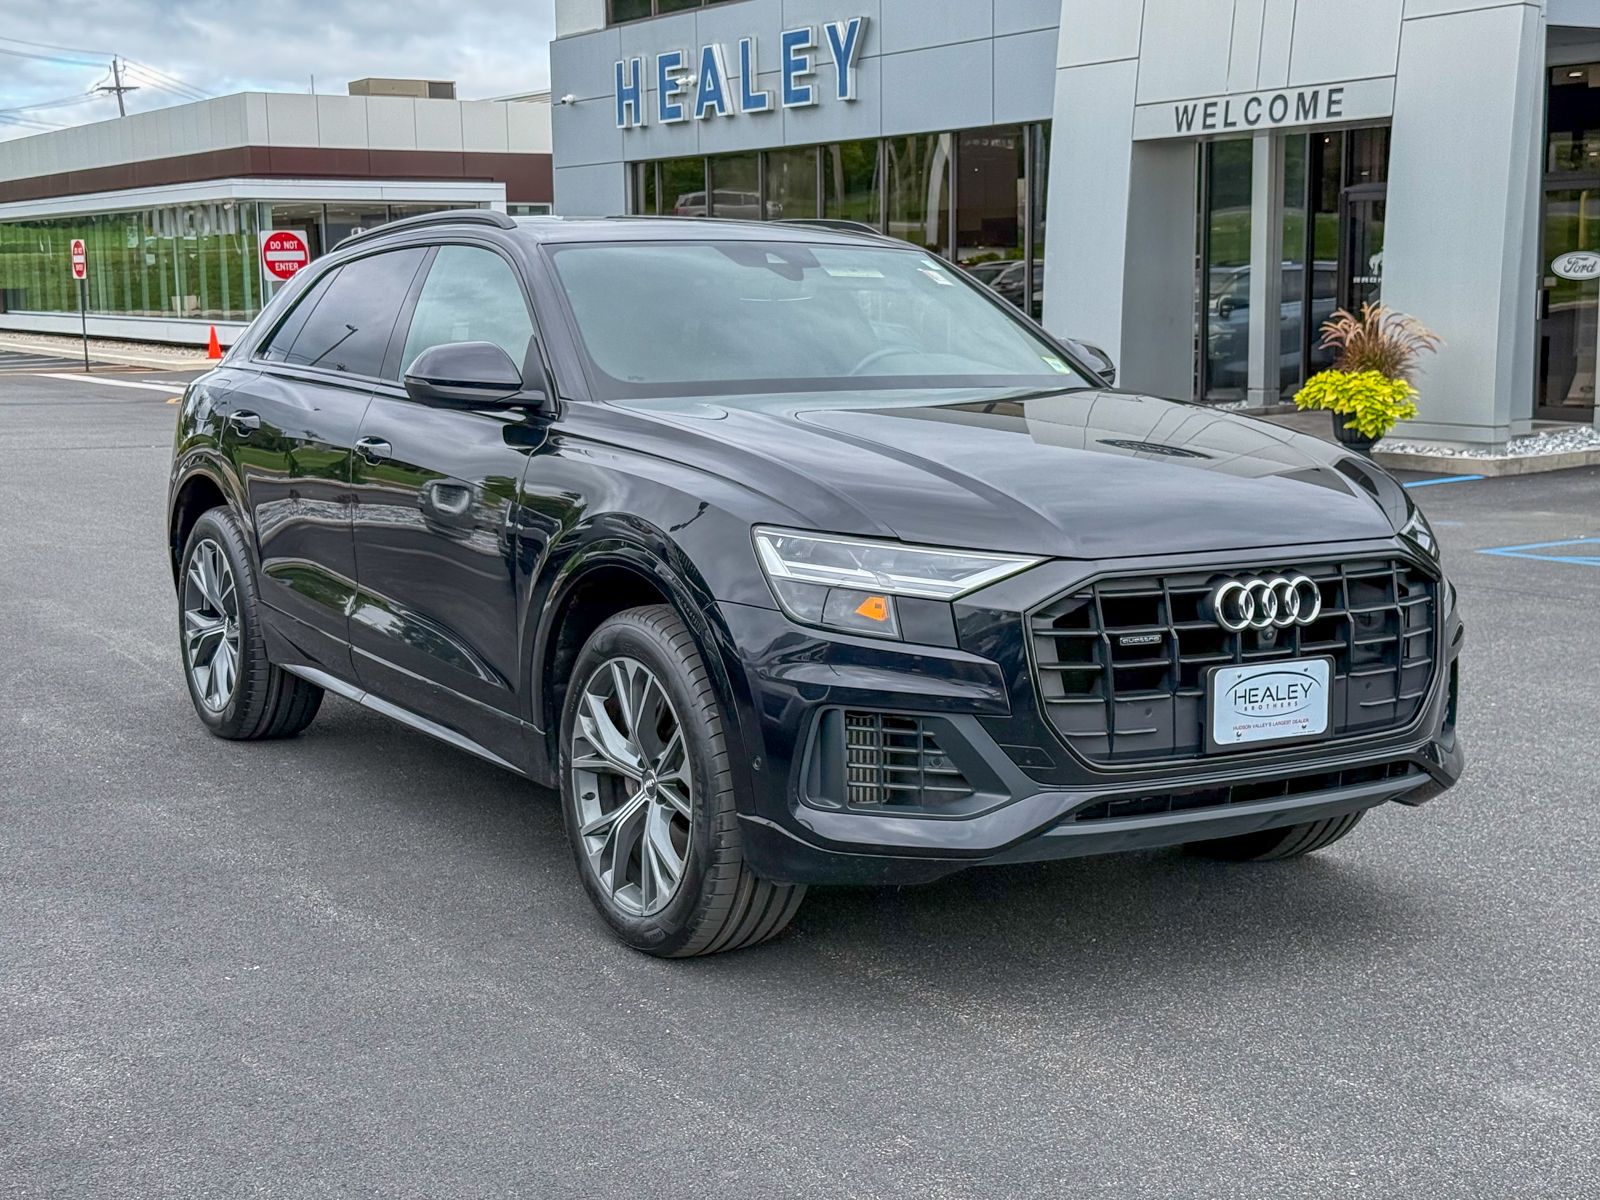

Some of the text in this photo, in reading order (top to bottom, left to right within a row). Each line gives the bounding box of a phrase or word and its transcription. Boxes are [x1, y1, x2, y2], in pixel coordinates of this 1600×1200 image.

[614, 16, 869, 129] HEALEY
[1174, 87, 1344, 133] WELCOME
[270, 241, 298, 250] DO NOT
[275, 262, 299, 272] ENTER
[1563, 257, 1597, 274] Ford
[1233, 681, 1313, 706] HEALEY
[1243, 701, 1299, 712] BROTHERS
[1292, 717, 1310, 725] DEALER
